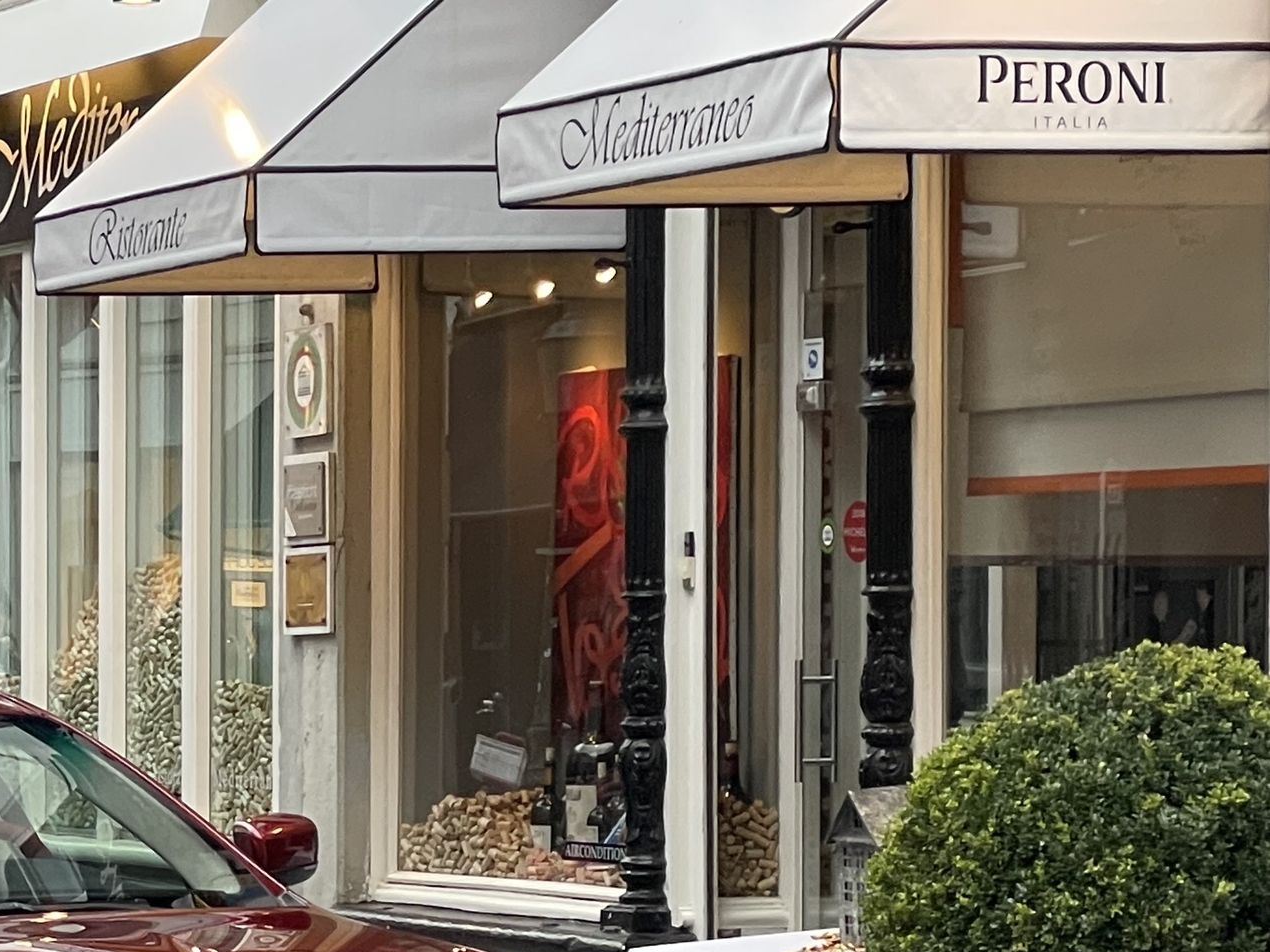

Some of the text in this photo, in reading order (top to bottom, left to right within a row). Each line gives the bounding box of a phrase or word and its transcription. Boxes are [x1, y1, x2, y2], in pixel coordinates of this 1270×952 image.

[977, 55, 1166, 105] PERONI
[560, 91, 755, 171] Mediterraneo
[1034, 115, 1108, 130] ITALIA
[89, 207, 188, 266] Ristorante
